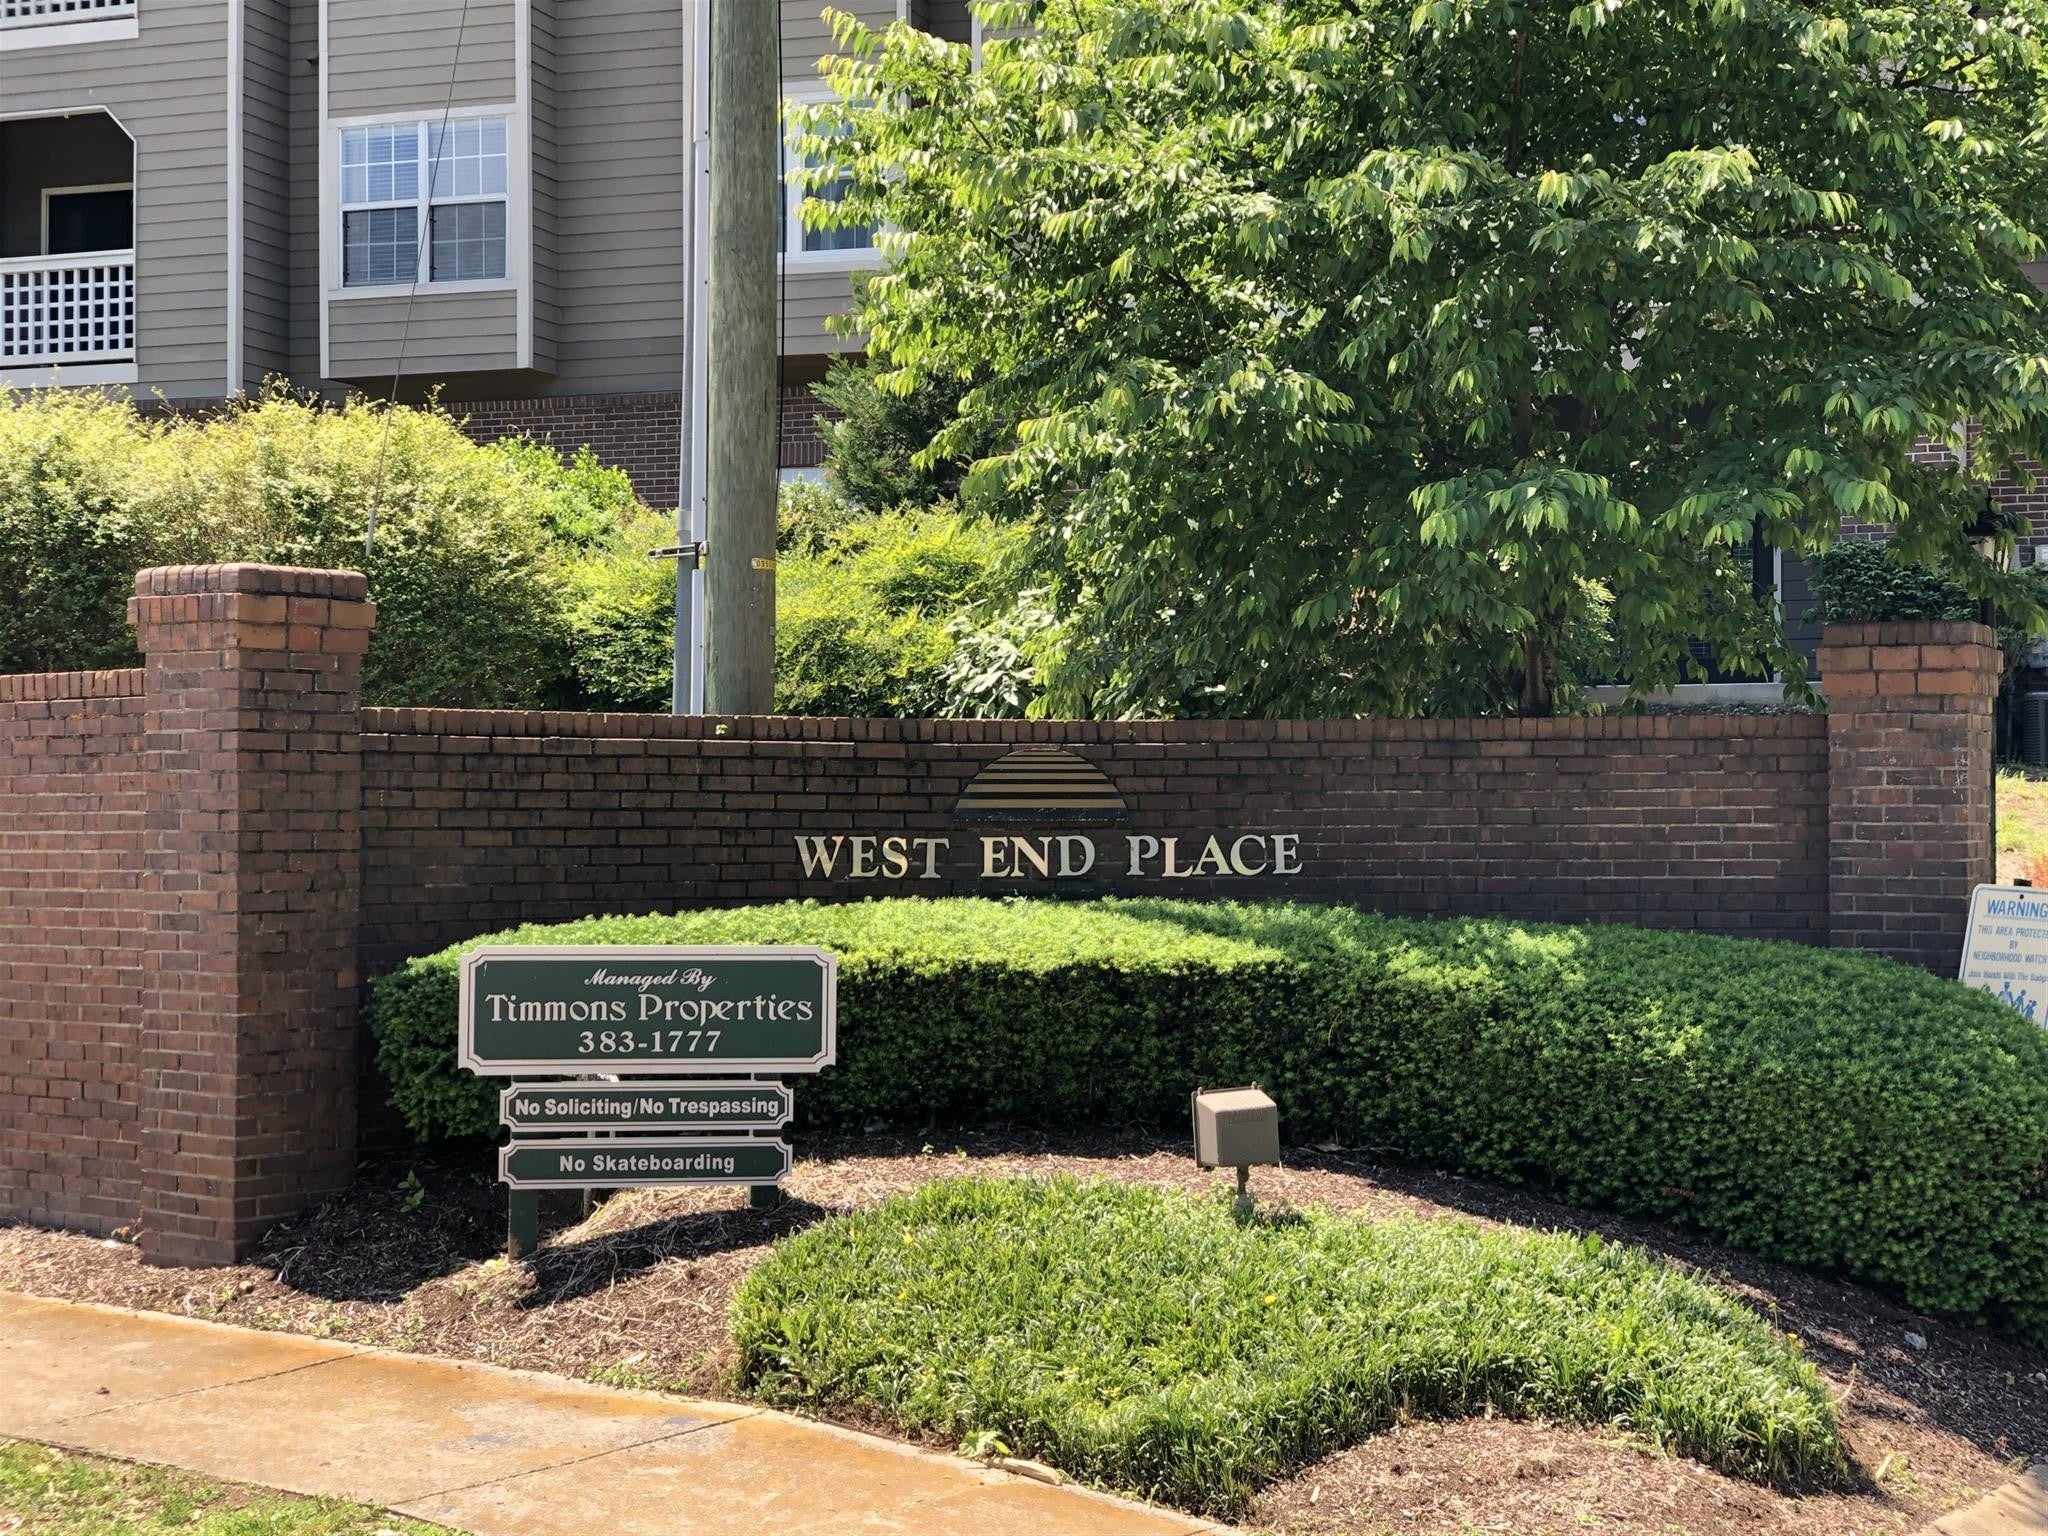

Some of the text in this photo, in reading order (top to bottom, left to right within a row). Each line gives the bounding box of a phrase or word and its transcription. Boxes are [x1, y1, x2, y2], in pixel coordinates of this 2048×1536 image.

[794, 832, 1303, 880] WEST END PLACE
[1987, 898, 2048, 918] WARNING
[1978, 924, 1993, 935] THIS
[1995, 925, 2013, 936] AREA
[2009, 940, 2018, 949] BY
[1973, 951, 2022, 962] NEIGHBORHOOD
[584, 967, 718, 993] Managed By
[485, 992, 813, 1027] Timmons Properties
[577, 1029, 722, 1055] 383-1777
[515, 1096, 779, 1119] No Soliciting/No Trespassing
[559, 1152, 735, 1174] No Skateboarding
